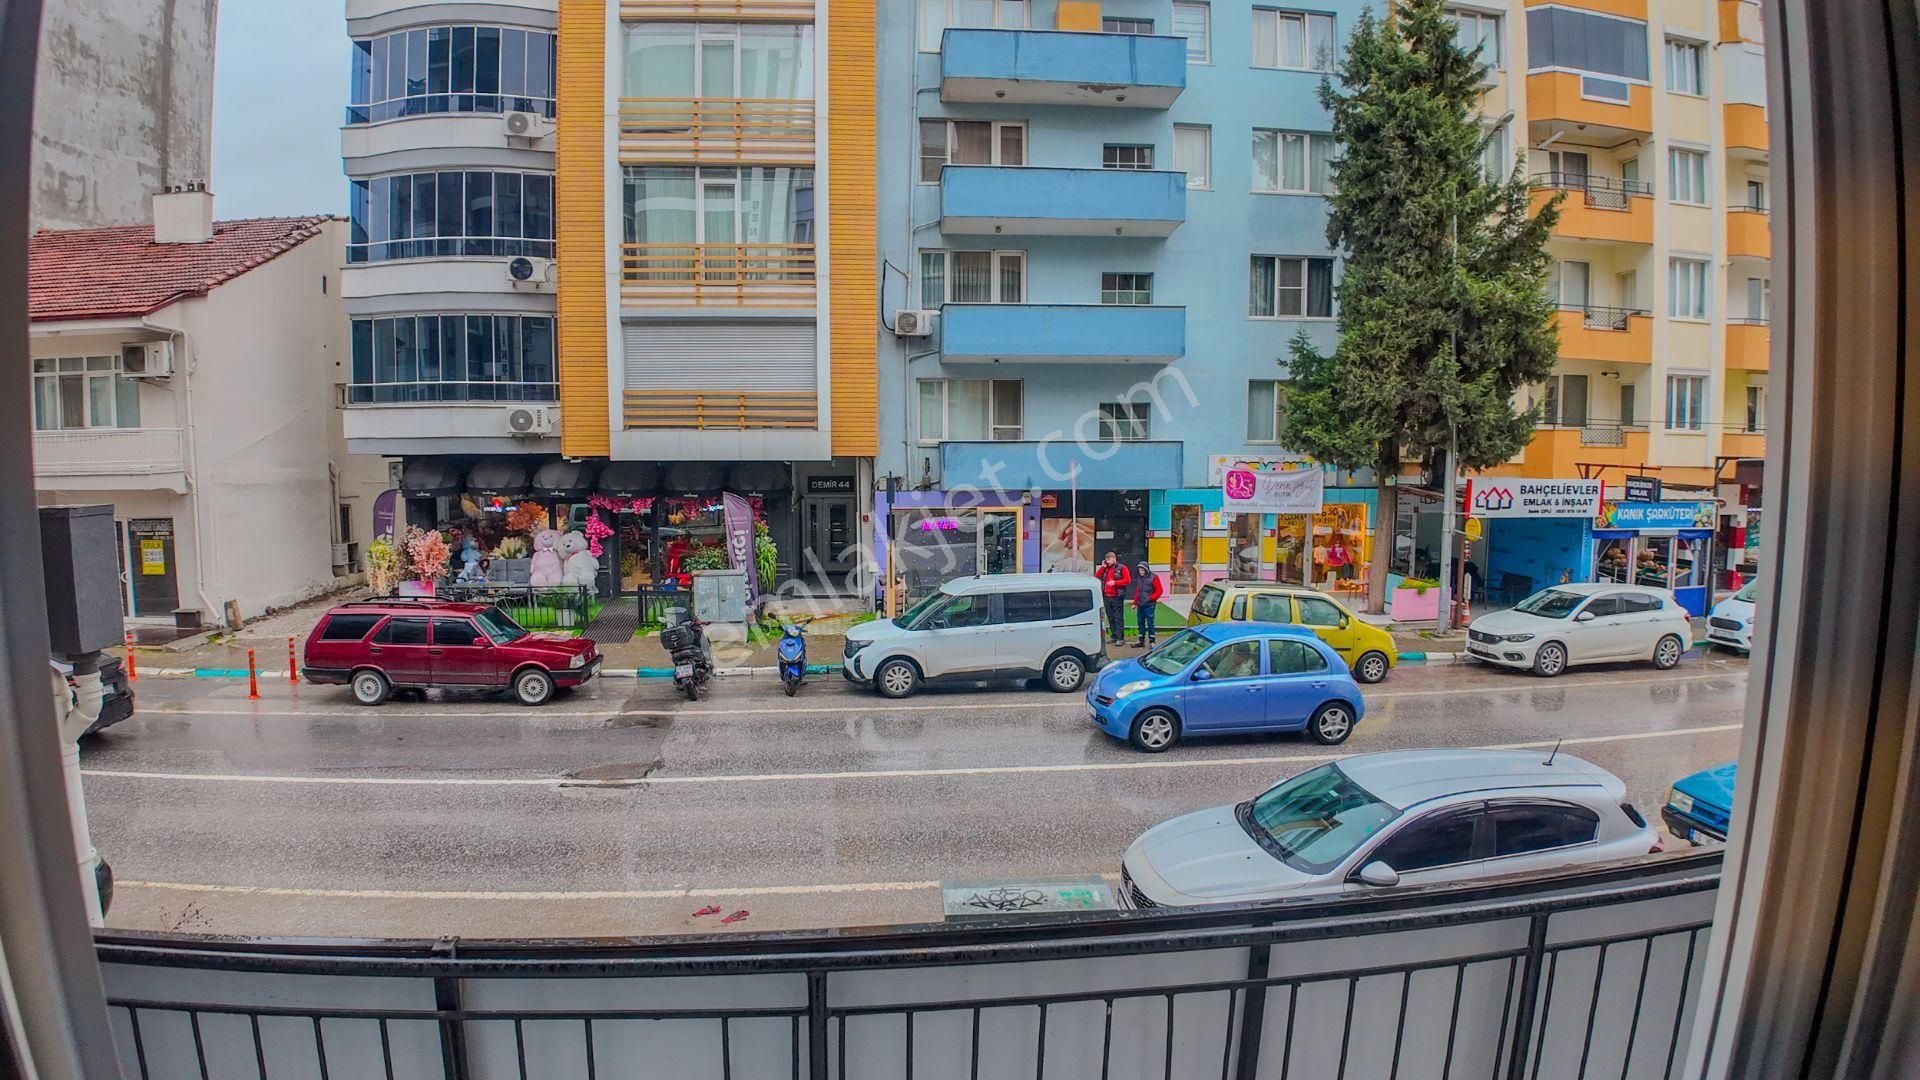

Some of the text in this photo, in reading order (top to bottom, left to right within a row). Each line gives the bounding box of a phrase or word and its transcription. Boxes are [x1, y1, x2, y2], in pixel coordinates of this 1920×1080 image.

[811, 480, 850, 489] DEMİR 44
[1520, 483, 1599, 497] BAHÇELİEVLER
[1561, 498, 1594, 508] İNŞAAT
[1617, 506, 1693, 523] KANIK ŞARKÜTERİ
